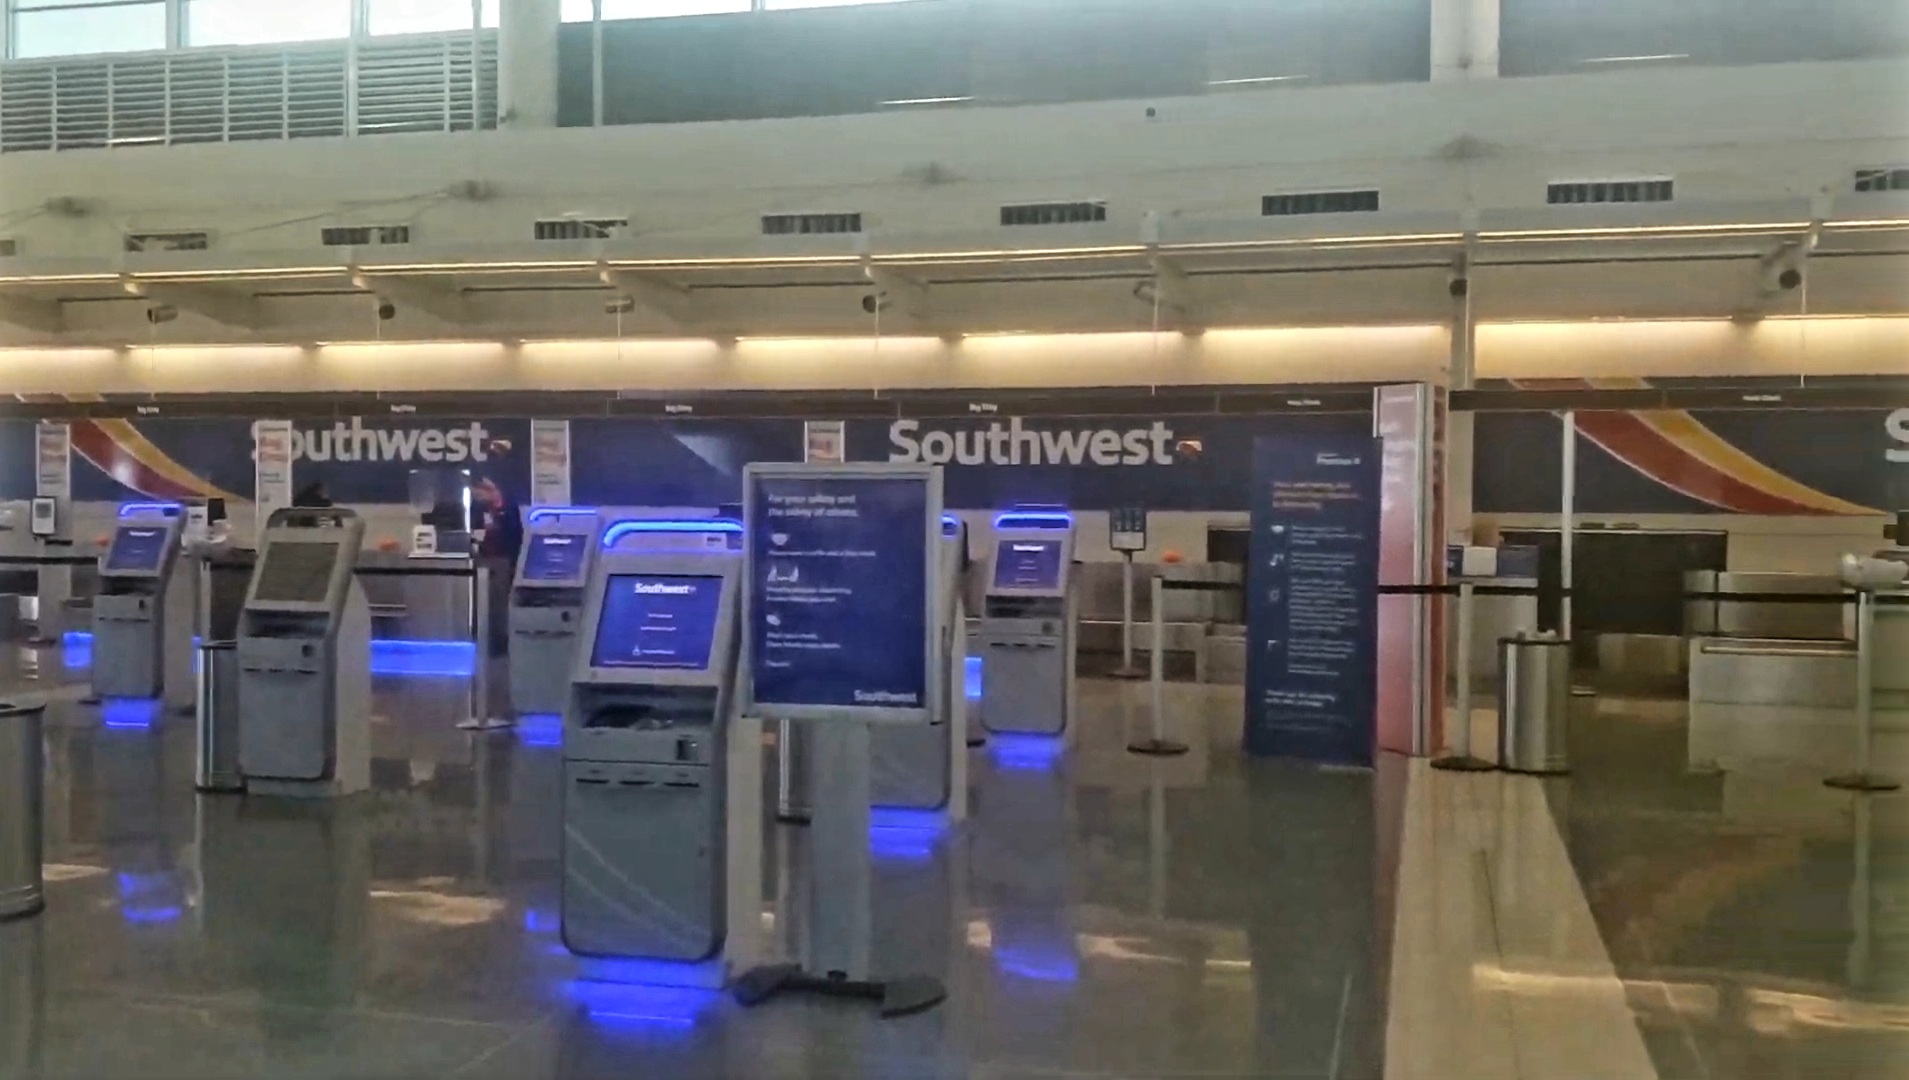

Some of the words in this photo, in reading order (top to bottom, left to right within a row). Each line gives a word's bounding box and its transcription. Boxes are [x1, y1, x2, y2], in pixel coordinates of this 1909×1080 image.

[889, 416, 1173, 465] Southwest
[635, 583, 688, 594] Southwest
[854, 689, 917, 702] Southwest
